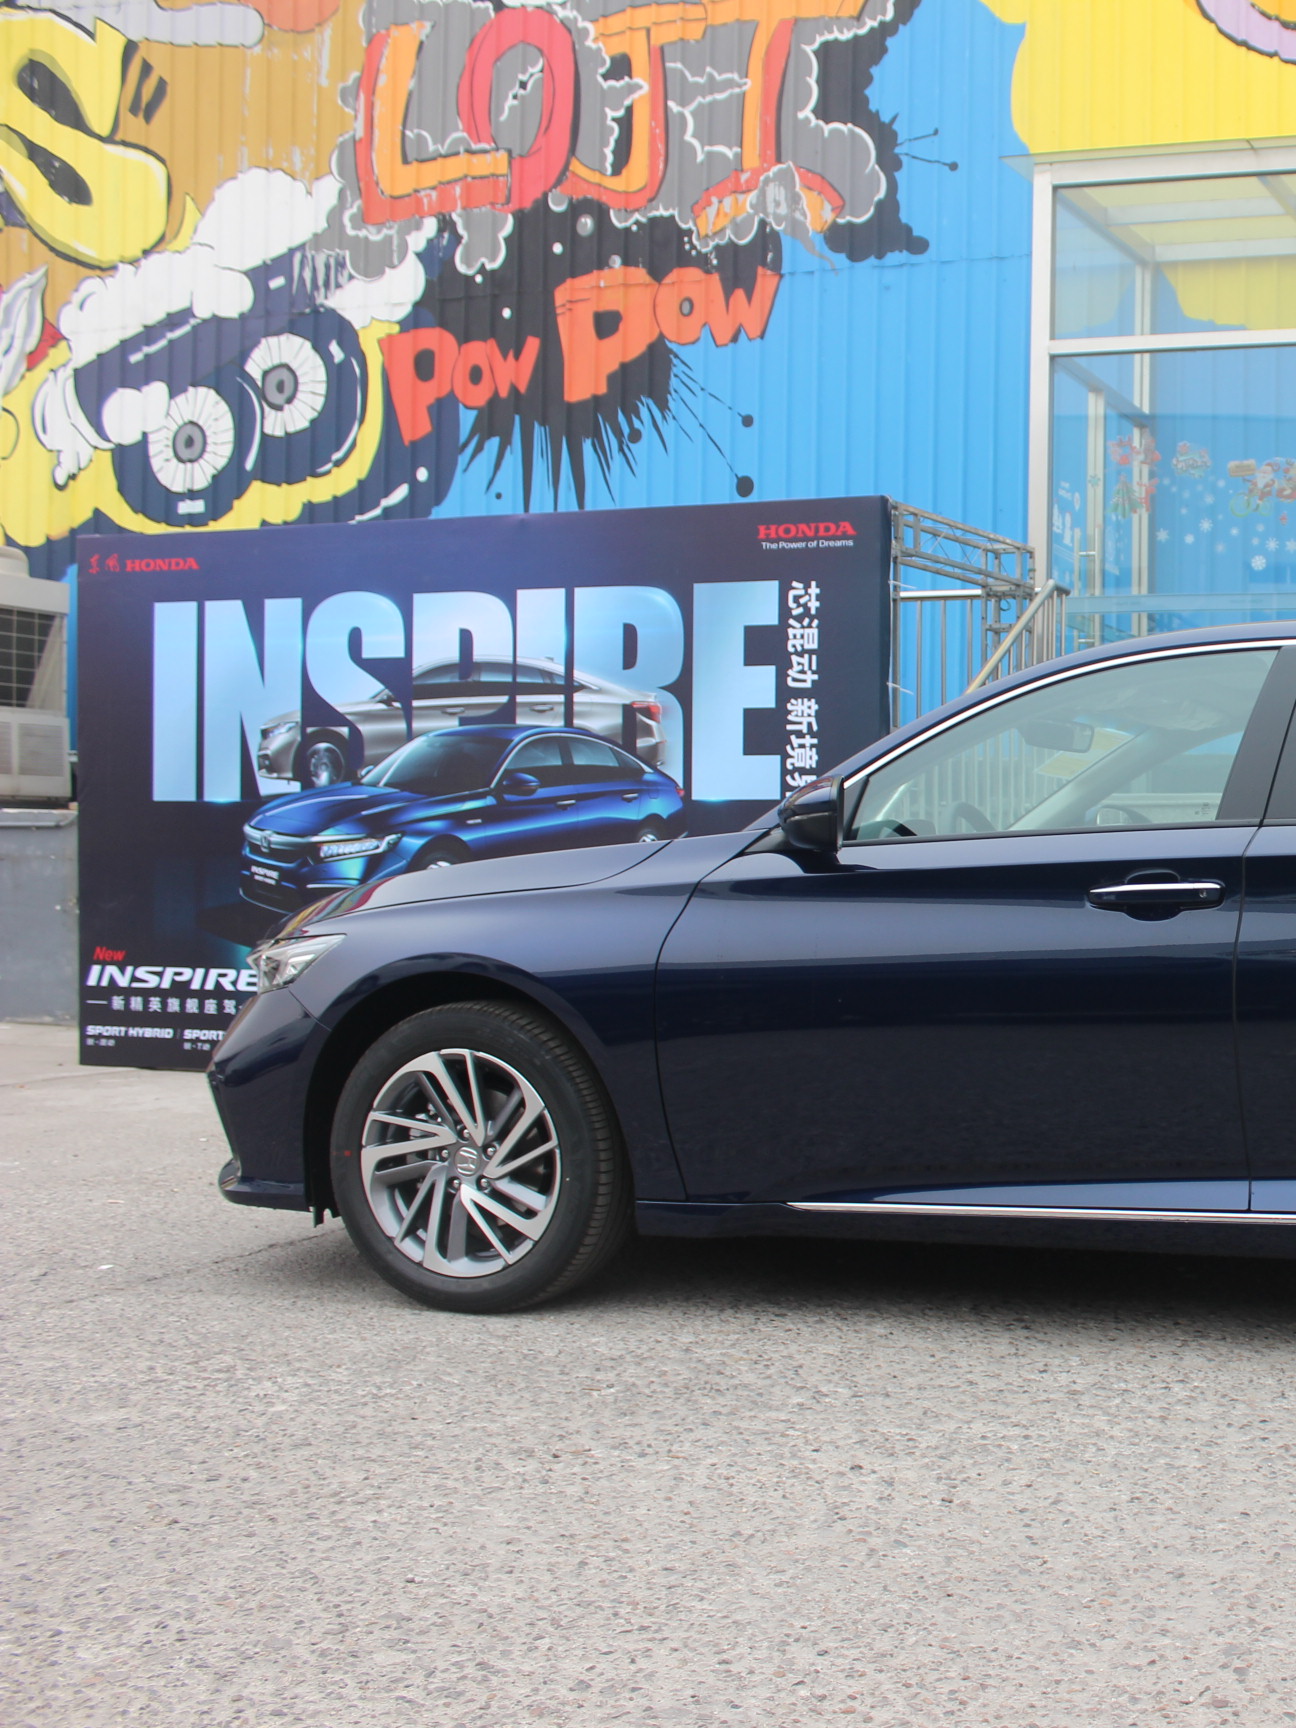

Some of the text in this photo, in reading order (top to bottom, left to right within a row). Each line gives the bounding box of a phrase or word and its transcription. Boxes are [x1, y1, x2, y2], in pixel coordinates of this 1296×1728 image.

[379, 265, 783, 446] POW POW
[757, 521, 857, 539] HONDA
[761, 539, 854, 550] The Power of Dreams
[125, 557, 200, 572] HONDA
[786, 580, 820, 688] 芯混动
[153, 581, 781, 801] INSPIRE
[93, 947, 126, 962] New
[86, 964, 257, 992] INSPIRE
[86, 1025, 127, 1037] SPORT
[128, 1027, 173, 1039] HYBRID
